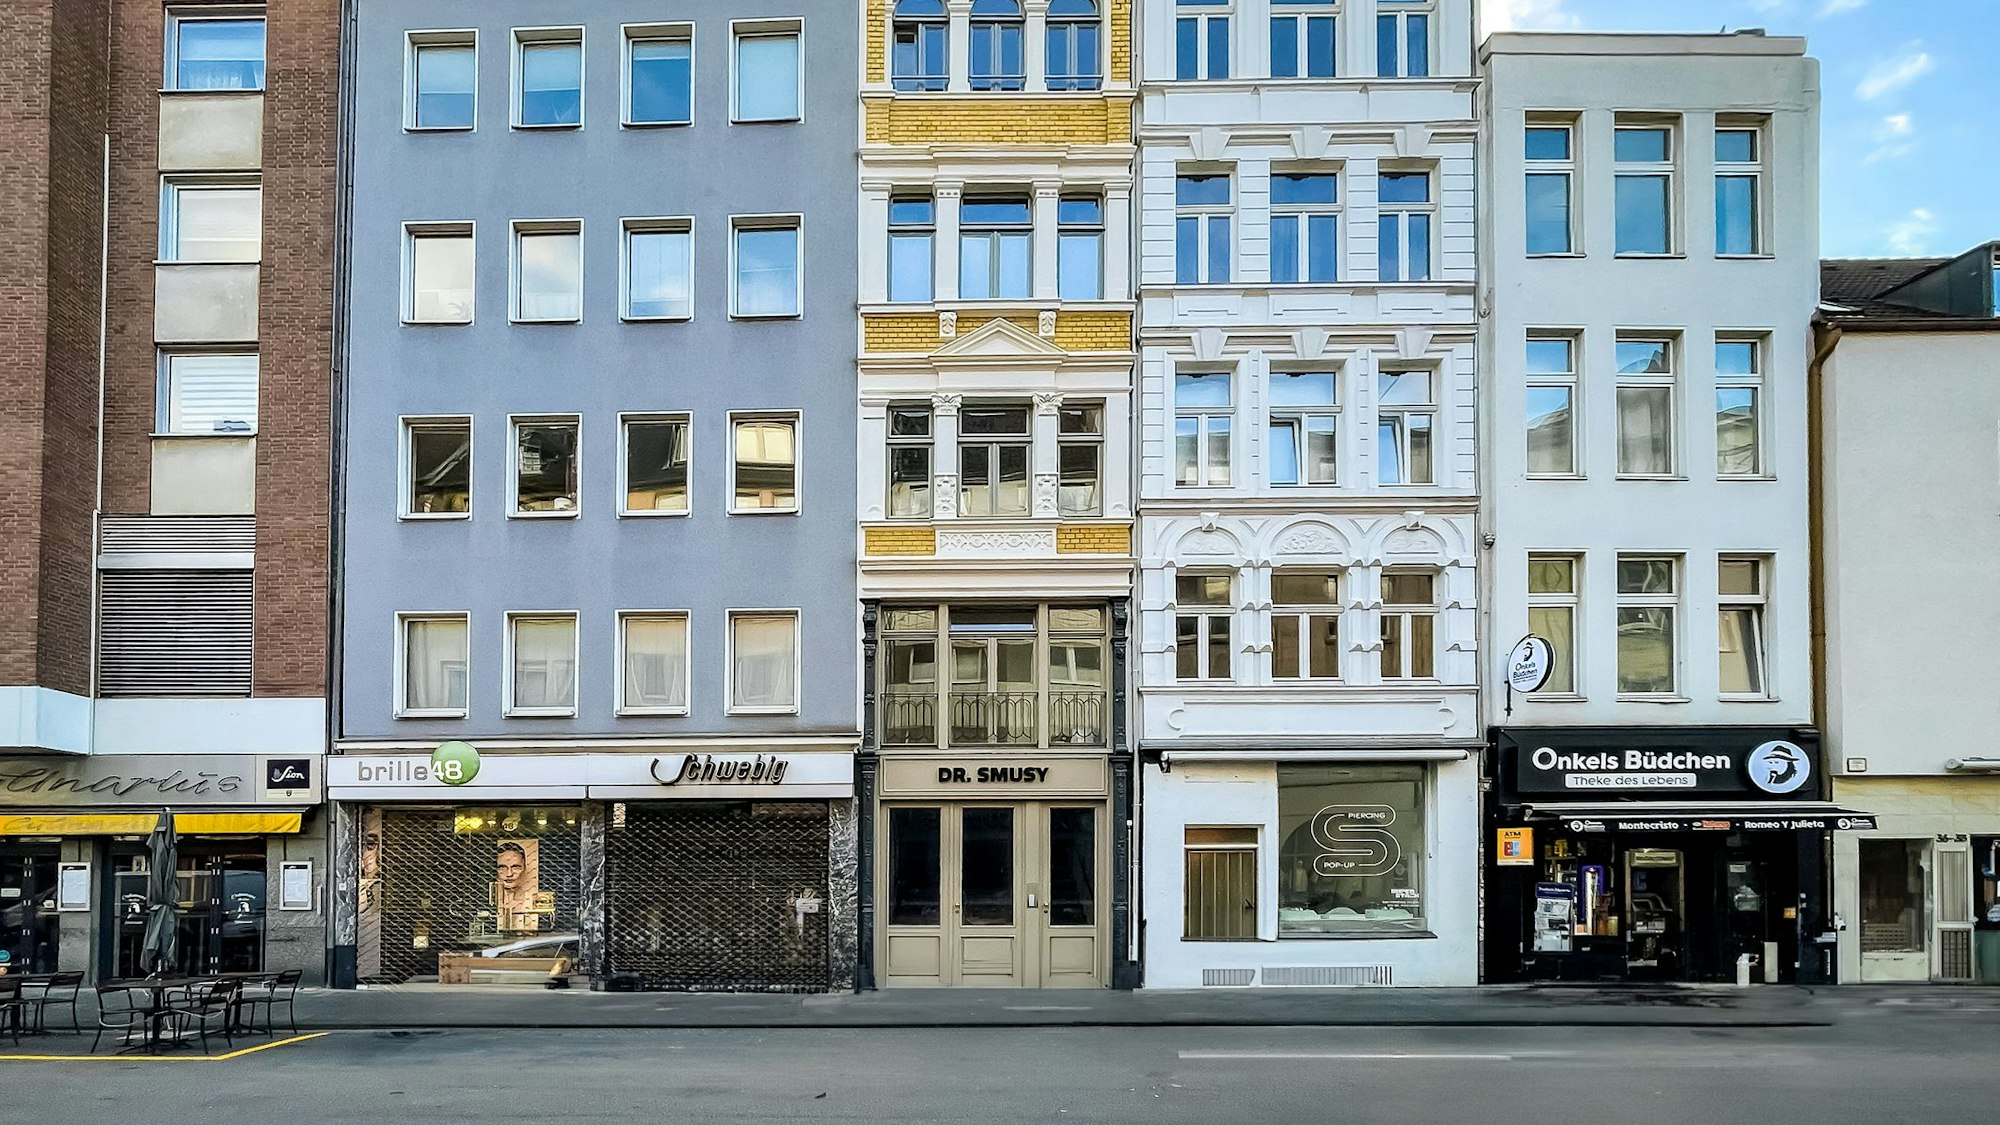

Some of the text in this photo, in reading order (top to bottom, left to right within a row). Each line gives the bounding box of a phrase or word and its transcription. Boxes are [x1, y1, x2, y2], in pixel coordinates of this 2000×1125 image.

[1532, 747, 1731, 771] Onkels Büdchen
[271, 765, 305, 783] Sion
[650, 752, 788, 785] Schwebig
[938, 767, 1049, 782] DR. SMUSY
[1573, 775, 1689, 786] Theke des Lebens
[1618, 820, 1680, 830] Montecristo
[1744, 819, 1825, 830] Romeo Y Julieta
[1323, 861, 1356, 869] POP-UP
